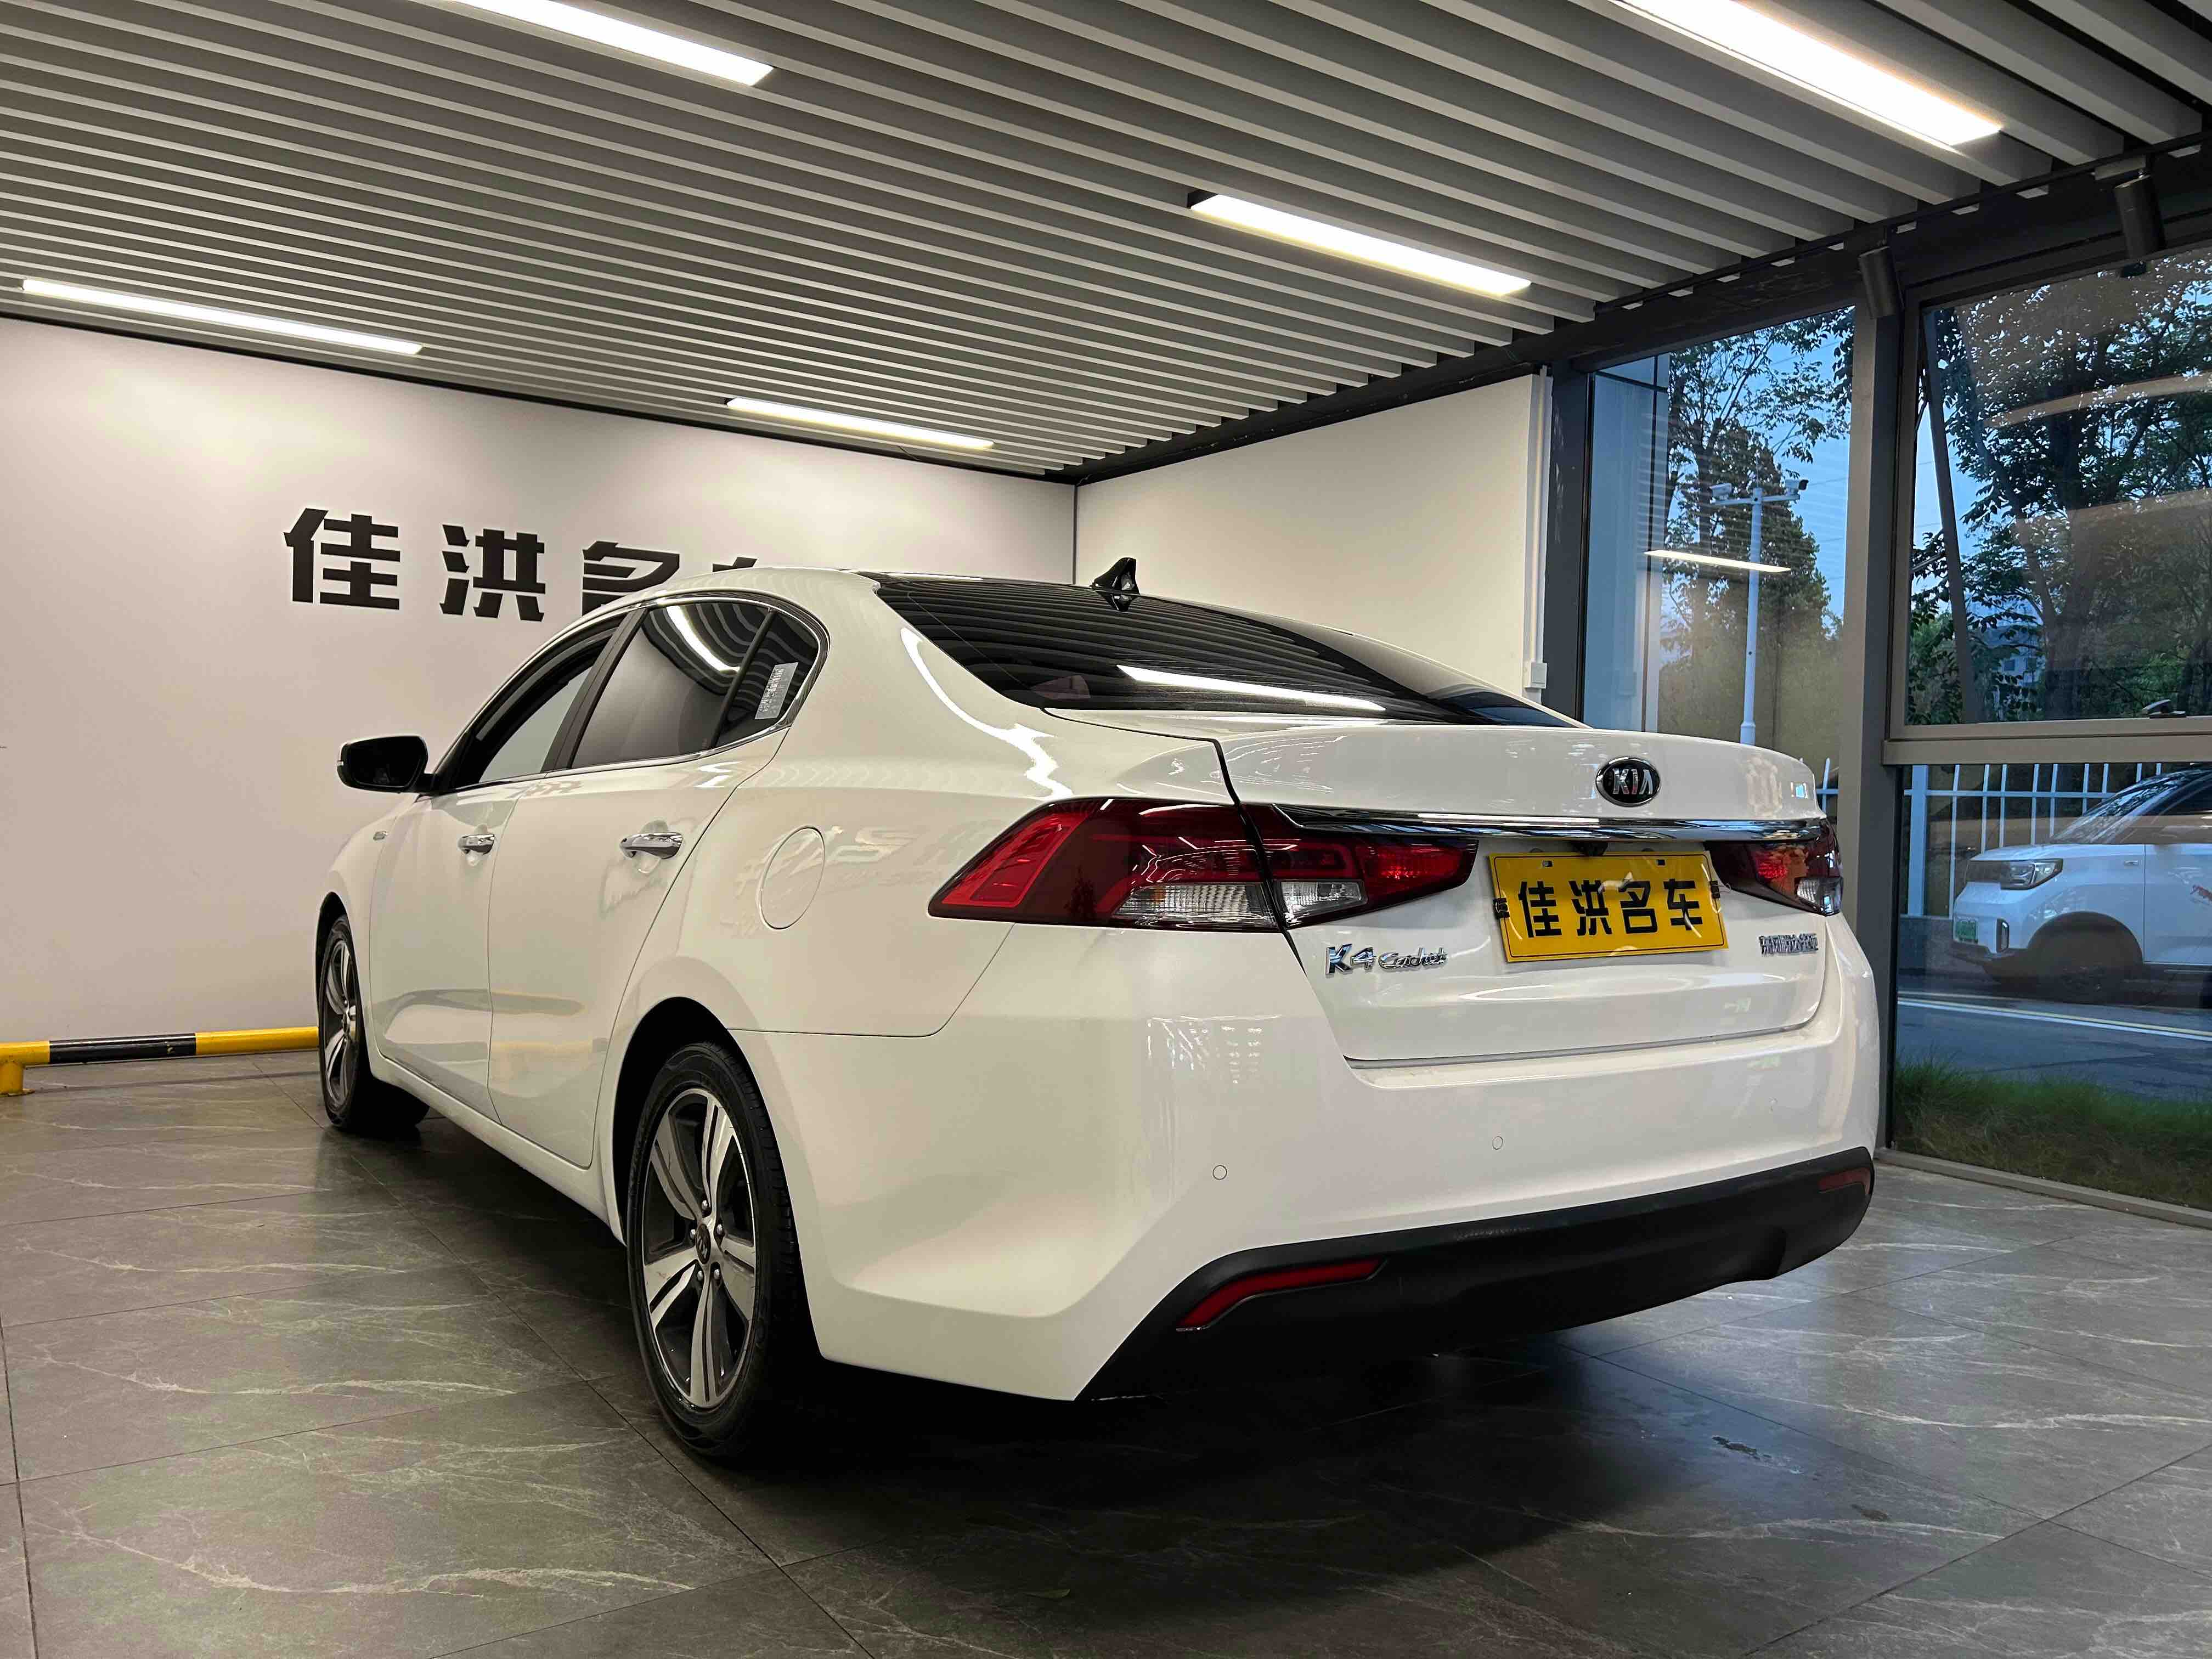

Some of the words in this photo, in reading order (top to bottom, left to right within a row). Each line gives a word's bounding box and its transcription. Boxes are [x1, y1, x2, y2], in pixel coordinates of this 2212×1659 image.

[283, 507, 759, 622] 佳洪名
[1612, 768, 1654, 795] KIA
[1518, 878, 1703, 938] 佳洪名车
[1325, 943, 1378, 975] K4
